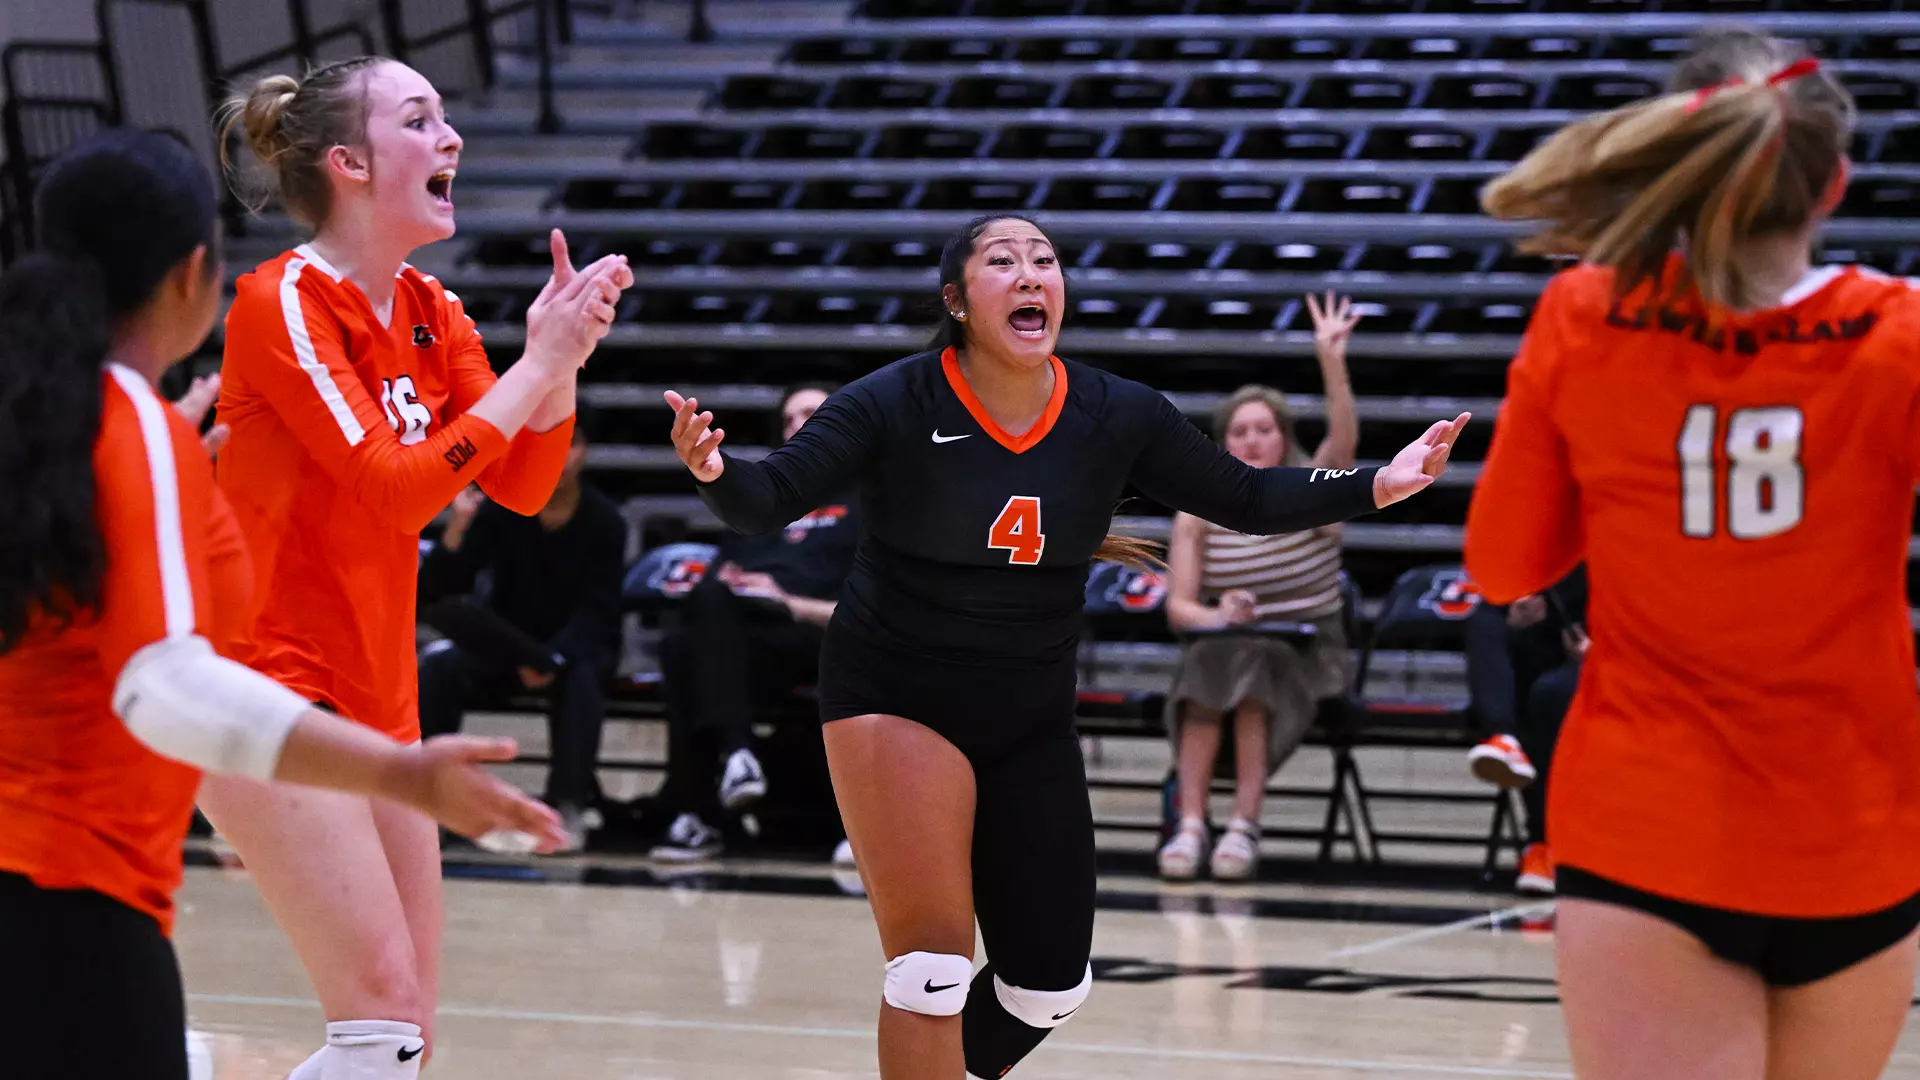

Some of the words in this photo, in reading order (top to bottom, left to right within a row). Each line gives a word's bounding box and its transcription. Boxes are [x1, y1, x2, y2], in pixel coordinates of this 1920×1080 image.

[381, 373, 432, 447] 16
[1678, 403, 1804, 540] 18
[987, 495, 1046, 566] 4
